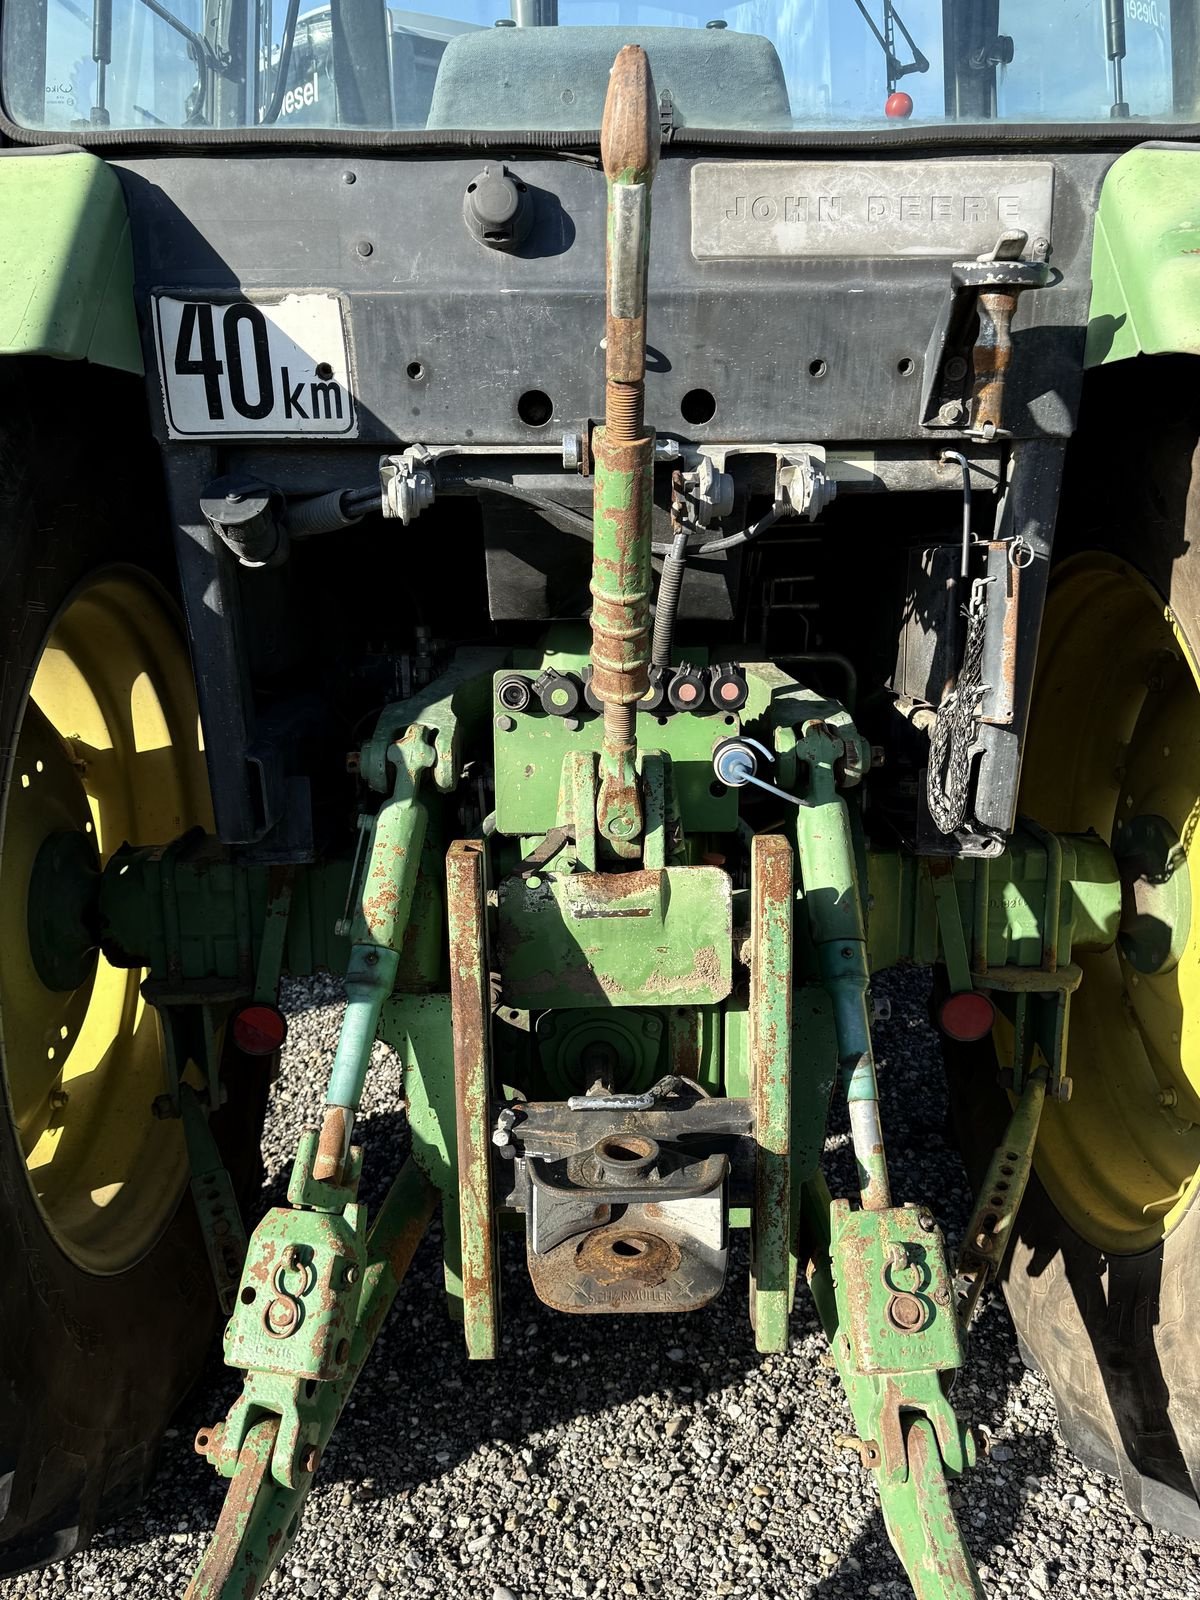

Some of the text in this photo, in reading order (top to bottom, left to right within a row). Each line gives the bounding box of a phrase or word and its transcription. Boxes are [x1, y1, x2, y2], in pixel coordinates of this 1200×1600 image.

[725, 195, 1021, 223] JOHN DEERE
[175, 303, 343, 420] 40 km
